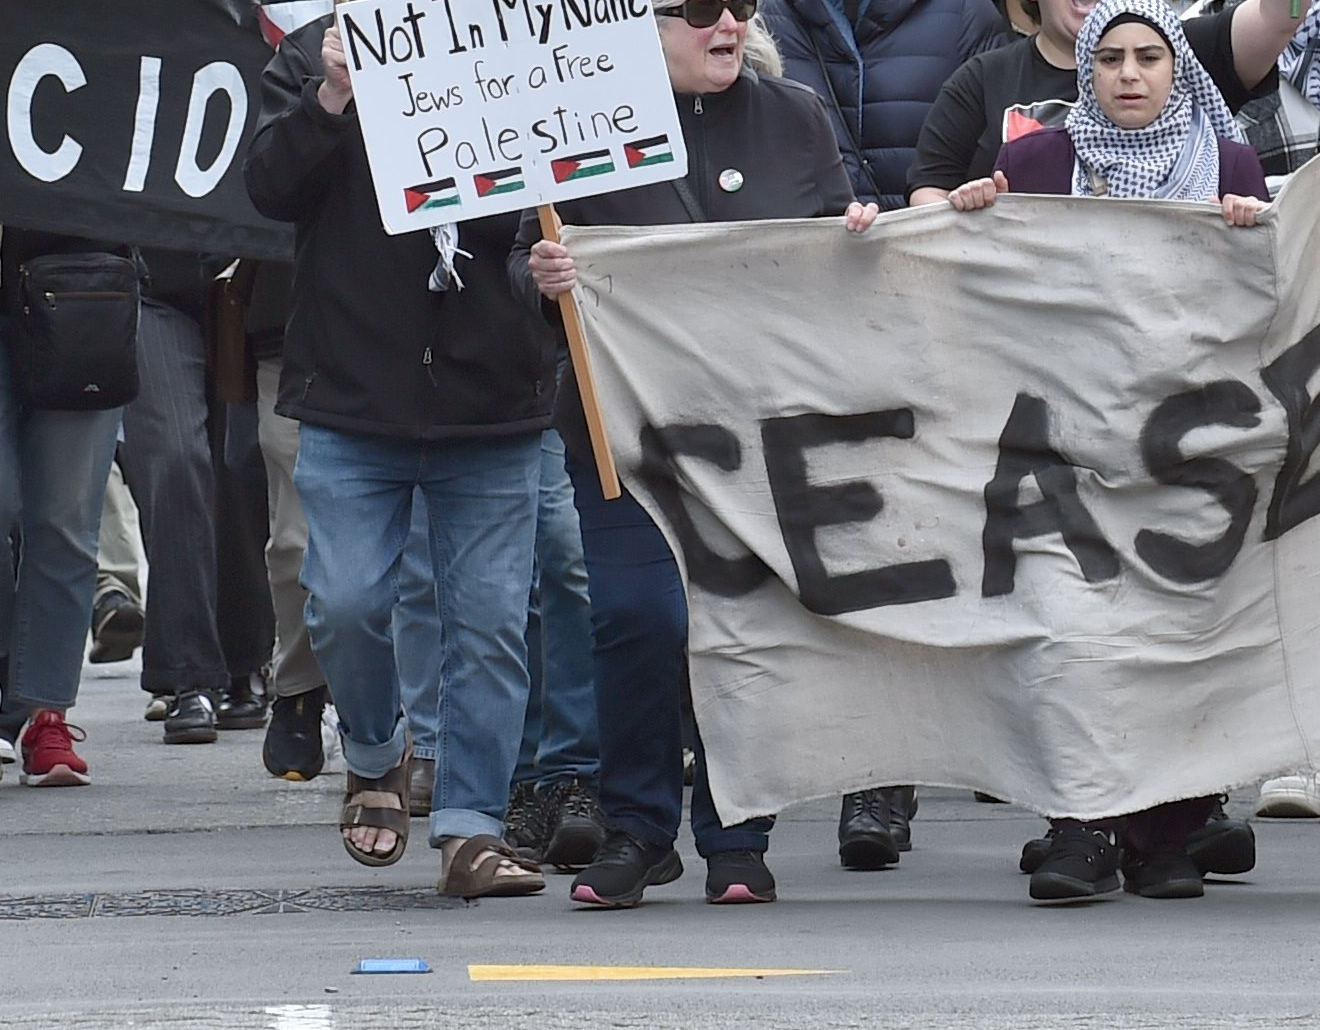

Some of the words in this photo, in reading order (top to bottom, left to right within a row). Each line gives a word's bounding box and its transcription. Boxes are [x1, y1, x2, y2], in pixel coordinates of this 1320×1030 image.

[342, 3, 426, 71] Not
[397, 73, 464, 117] Jews
[474, 60, 518, 104] for
[528, 65, 548, 89] a
[553, 45, 615, 85] Free
[416, 103, 639, 178] Palestine
